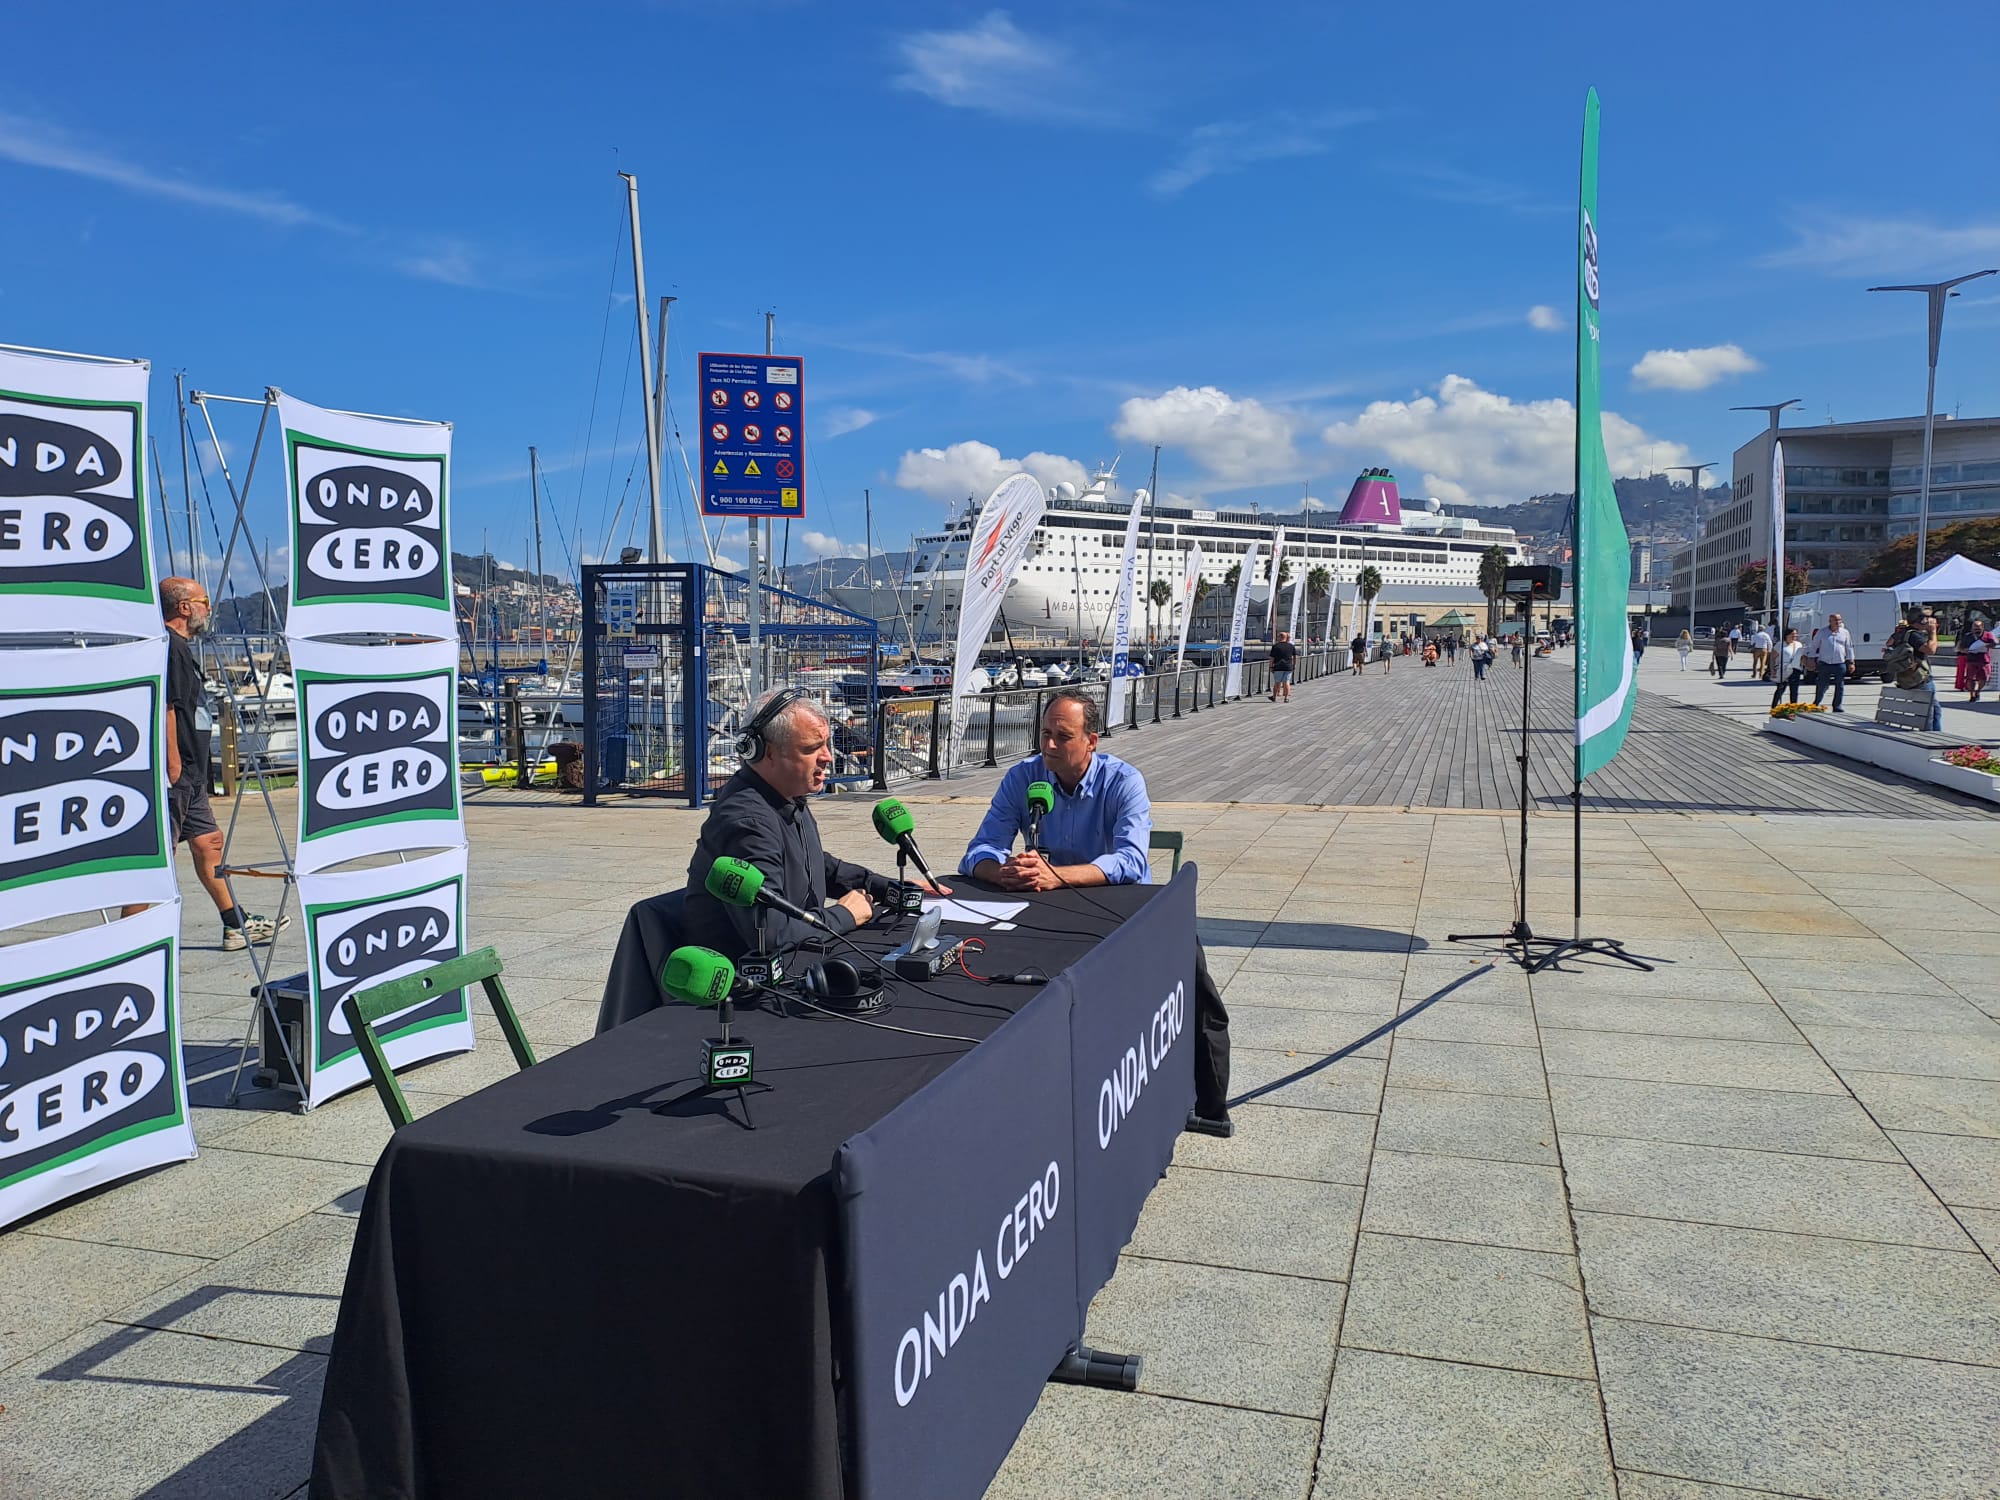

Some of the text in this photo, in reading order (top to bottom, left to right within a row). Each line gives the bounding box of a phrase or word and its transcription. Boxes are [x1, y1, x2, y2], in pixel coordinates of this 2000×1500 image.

[0, 437, 105, 477] NDA
[318, 478, 423, 513] ONDA
[735, 496, 748, 504] 100
[0, 508, 109, 552] ERO
[980, 559, 1000, 588] Port
[997, 541, 1008, 557] of
[1004, 511, 1023, 540] Vigo
[326, 537, 424, 571] CERO
[327, 705, 431, 740] ONDA
[1, 725, 123, 765] NDA
[335, 759, 432, 799] CERO
[13, 794, 125, 846] ERO
[338, 917, 440, 967] ONDA
[718, 1058, 745, 1066] ONDA
[720, 1068, 744, 1076] CERO
[1098, 979, 1185, 1150] ONDA CERO
[0, 1062, 143, 1143] CERO
[894, 1160, 1060, 1407] ONDA CERO
